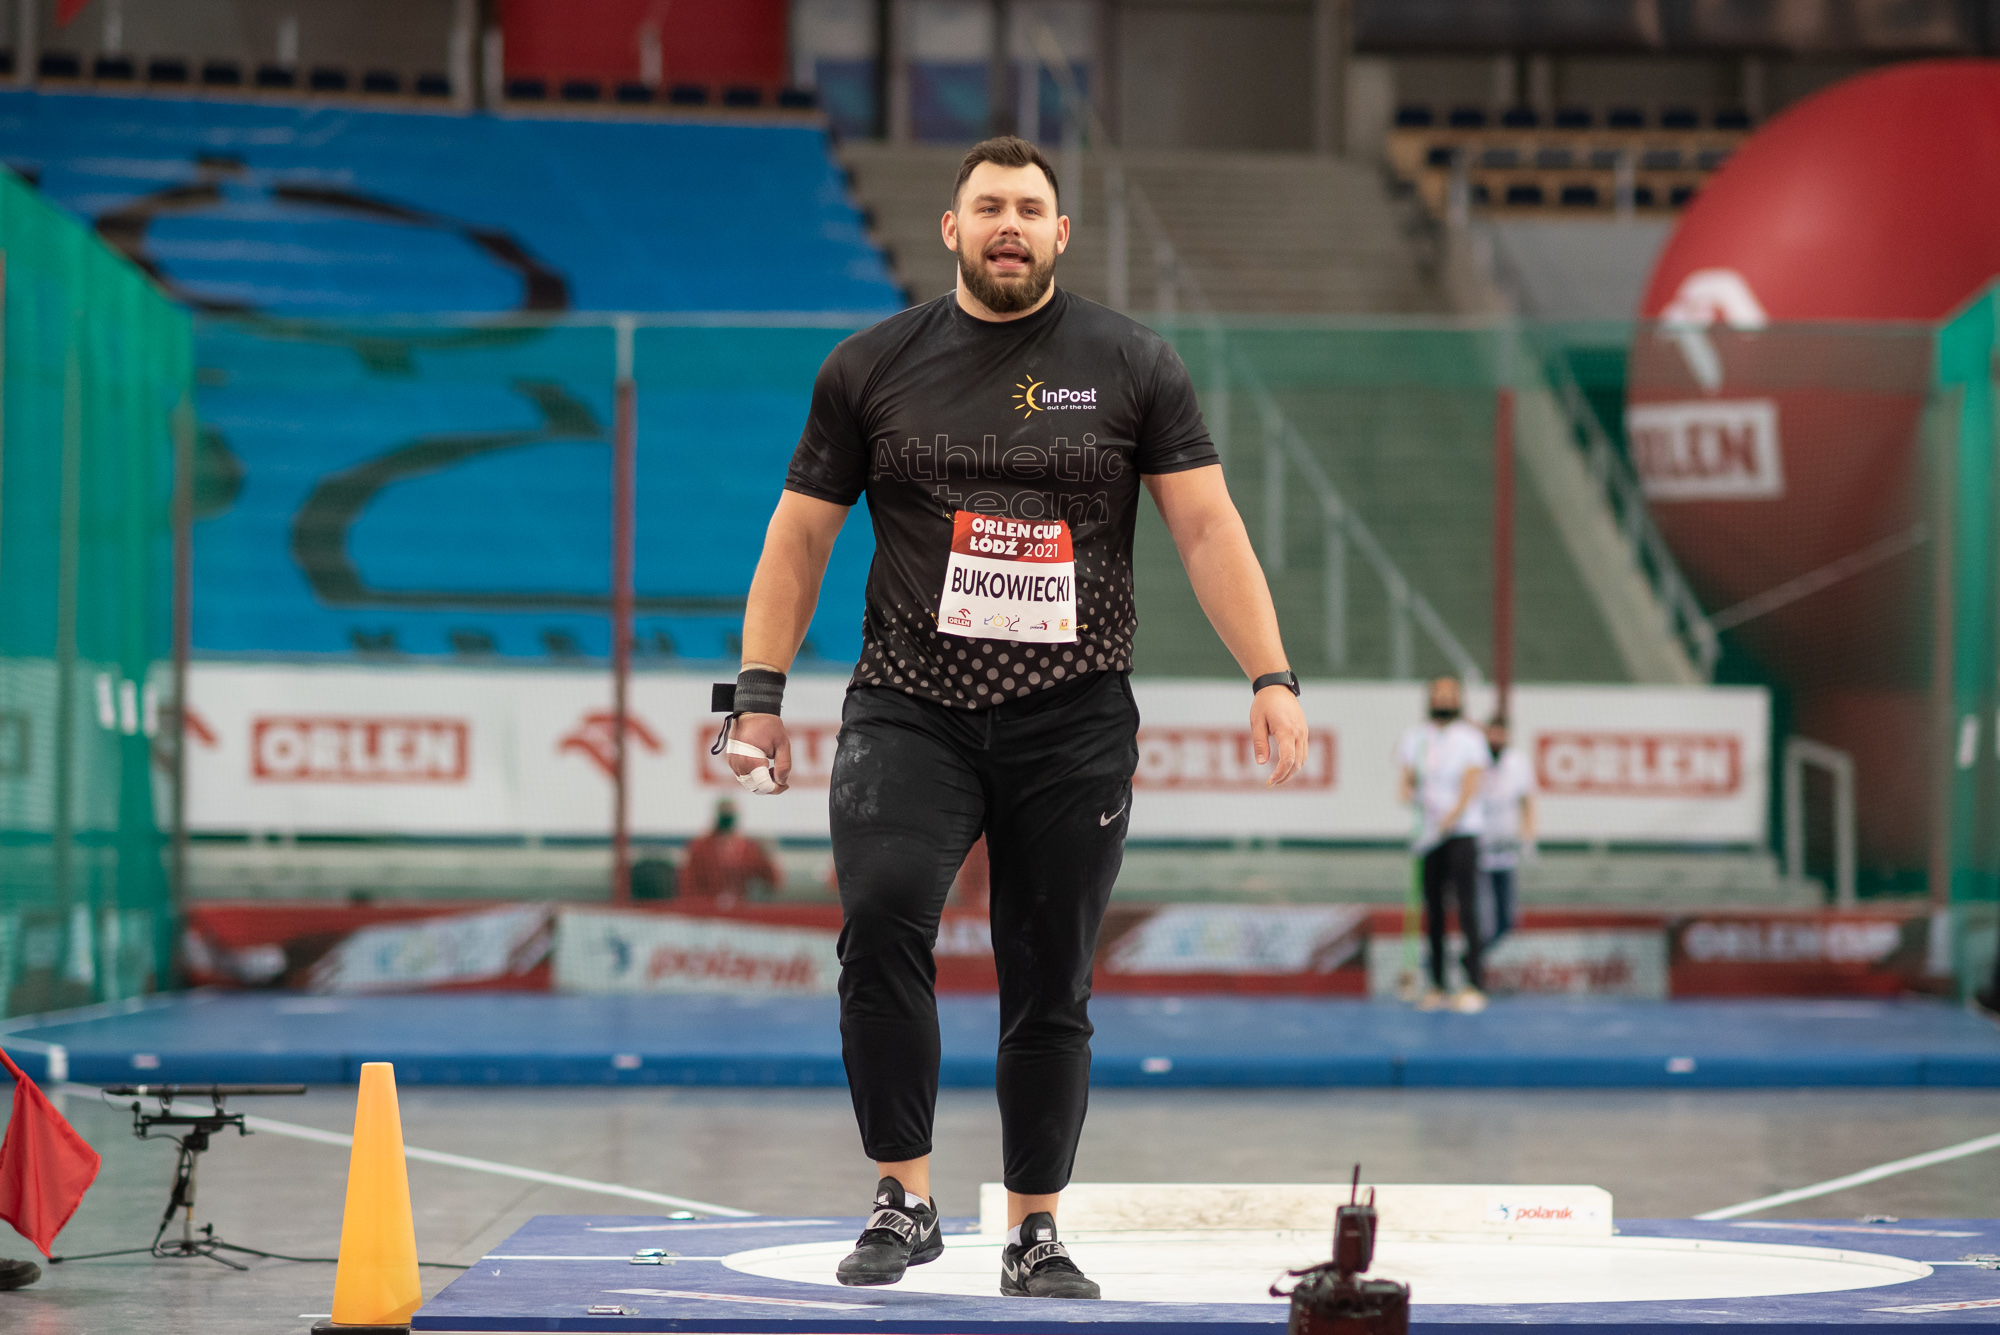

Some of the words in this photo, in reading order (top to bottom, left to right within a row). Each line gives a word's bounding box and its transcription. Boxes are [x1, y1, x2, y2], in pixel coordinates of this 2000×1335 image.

[1042, 387, 1097, 403] InPost
[873, 432, 1124, 482] Athletic
[931, 484, 1108, 526] team
[971, 517, 1031, 539] ORLEN
[1032, 524, 1062, 540] CUP
[969, 534, 1019, 556] ŁÓDŹ
[1023, 543, 1059, 558] 2021
[951, 566, 1070, 603] BUKOWIECKI
[948, 617, 970, 627] ORLEN
[258, 726, 456, 774] ORLEN
[1544, 743, 1731, 785] ORLEN
[1515, 1206, 1573, 1221] polanik
